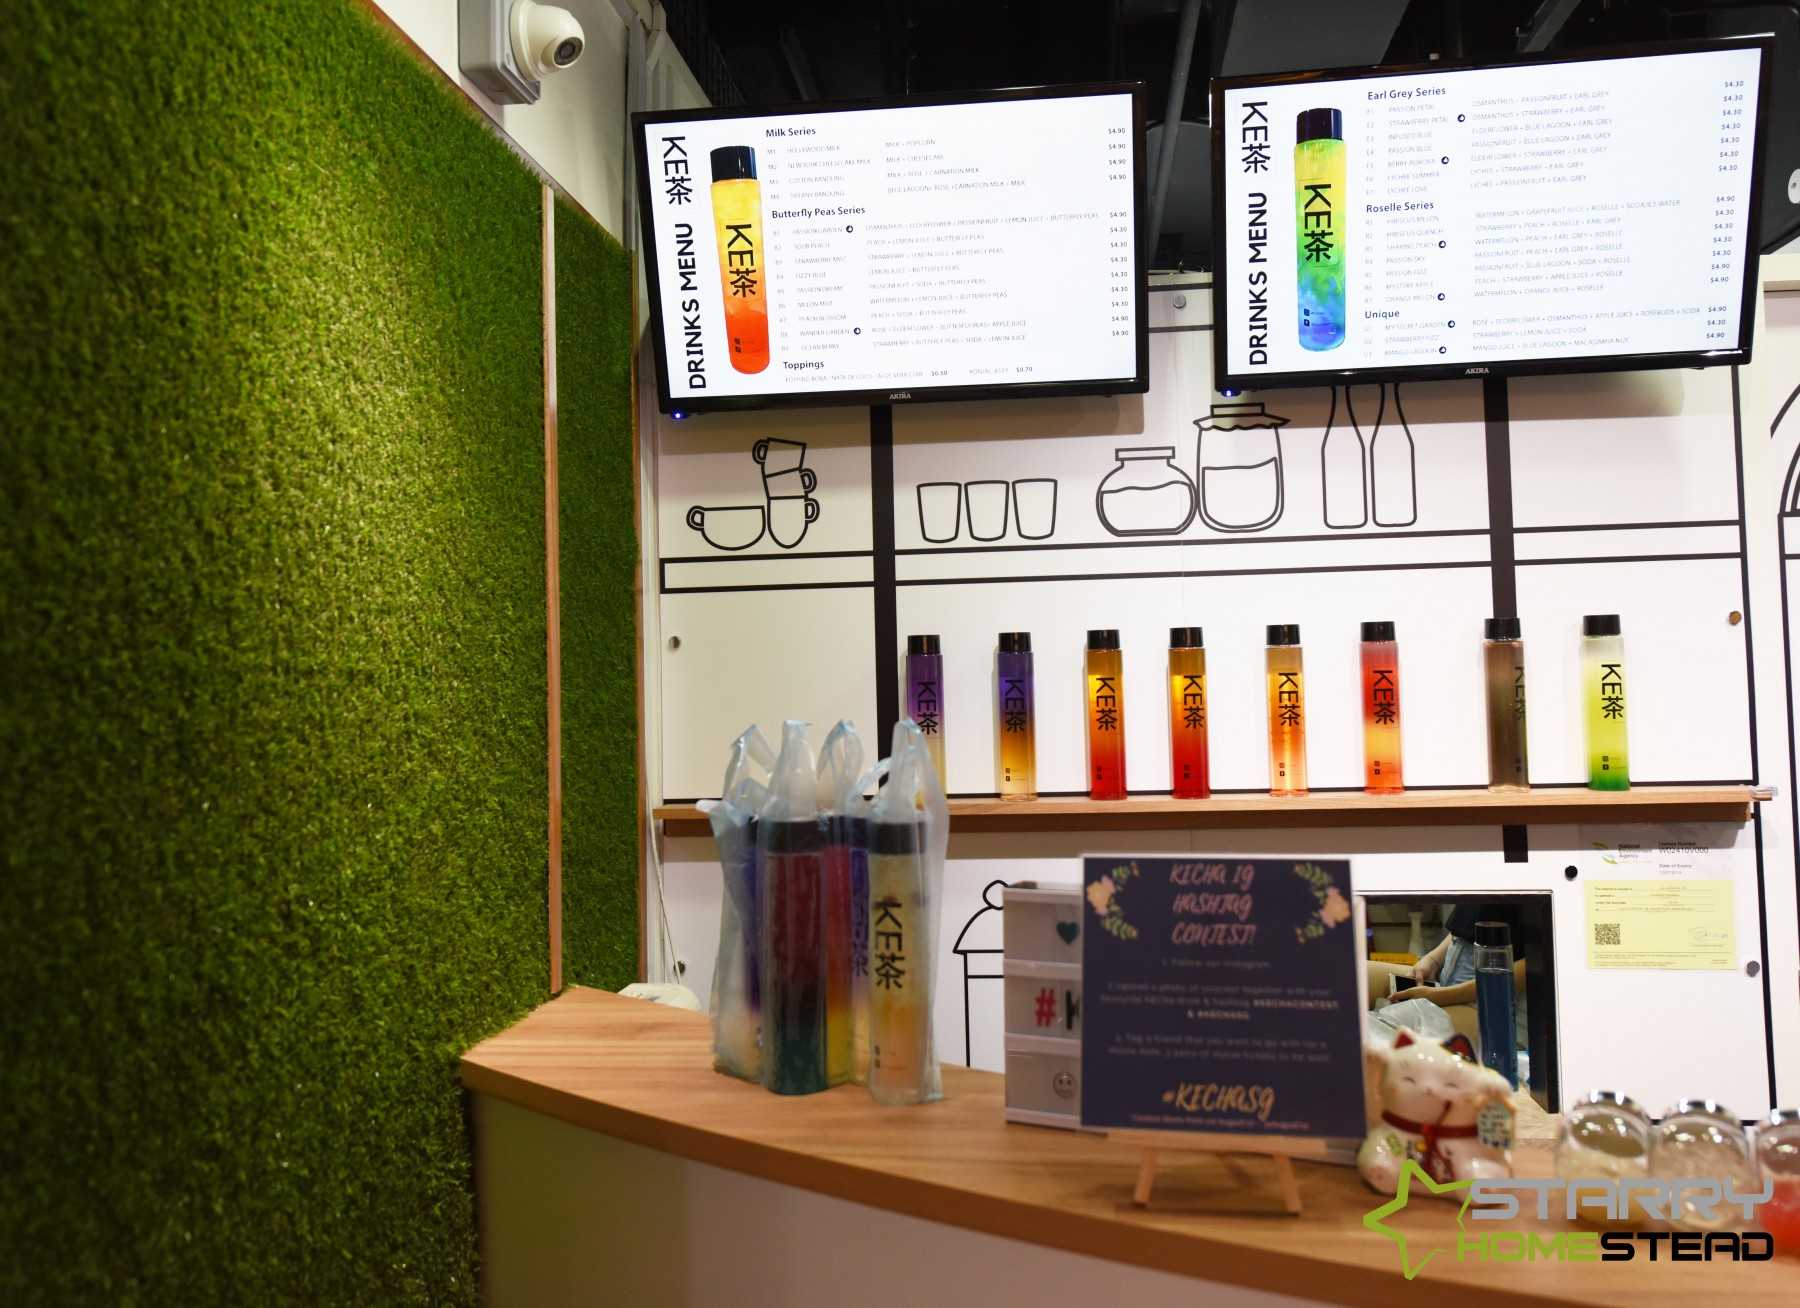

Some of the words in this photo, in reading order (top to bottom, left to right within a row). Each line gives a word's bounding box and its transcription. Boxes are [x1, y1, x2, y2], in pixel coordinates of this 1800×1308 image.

[1368, 91, 1386, 100] Earl
[1389, 89, 1413, 99] Grey
[1416, 87, 1446, 96] Series
[766, 129, 786, 138] Milk
[788, 128, 816, 137] Series
[772, 208, 812, 219] Butterfly
[815, 208, 835, 216] Peas
[838, 206, 866, 215] Series
[1366, 203, 1401, 213] Roselle
[1404, 202, 1434, 211] Series
[1248, 192, 1267, 263] MENU
[675, 223, 697, 291] MENU
[1249, 271, 1267, 365] DRINKS
[1365, 310, 1400, 320] Unique
[682, 299, 706, 389] DRINKS
[783, 360, 825, 370] Toppings
